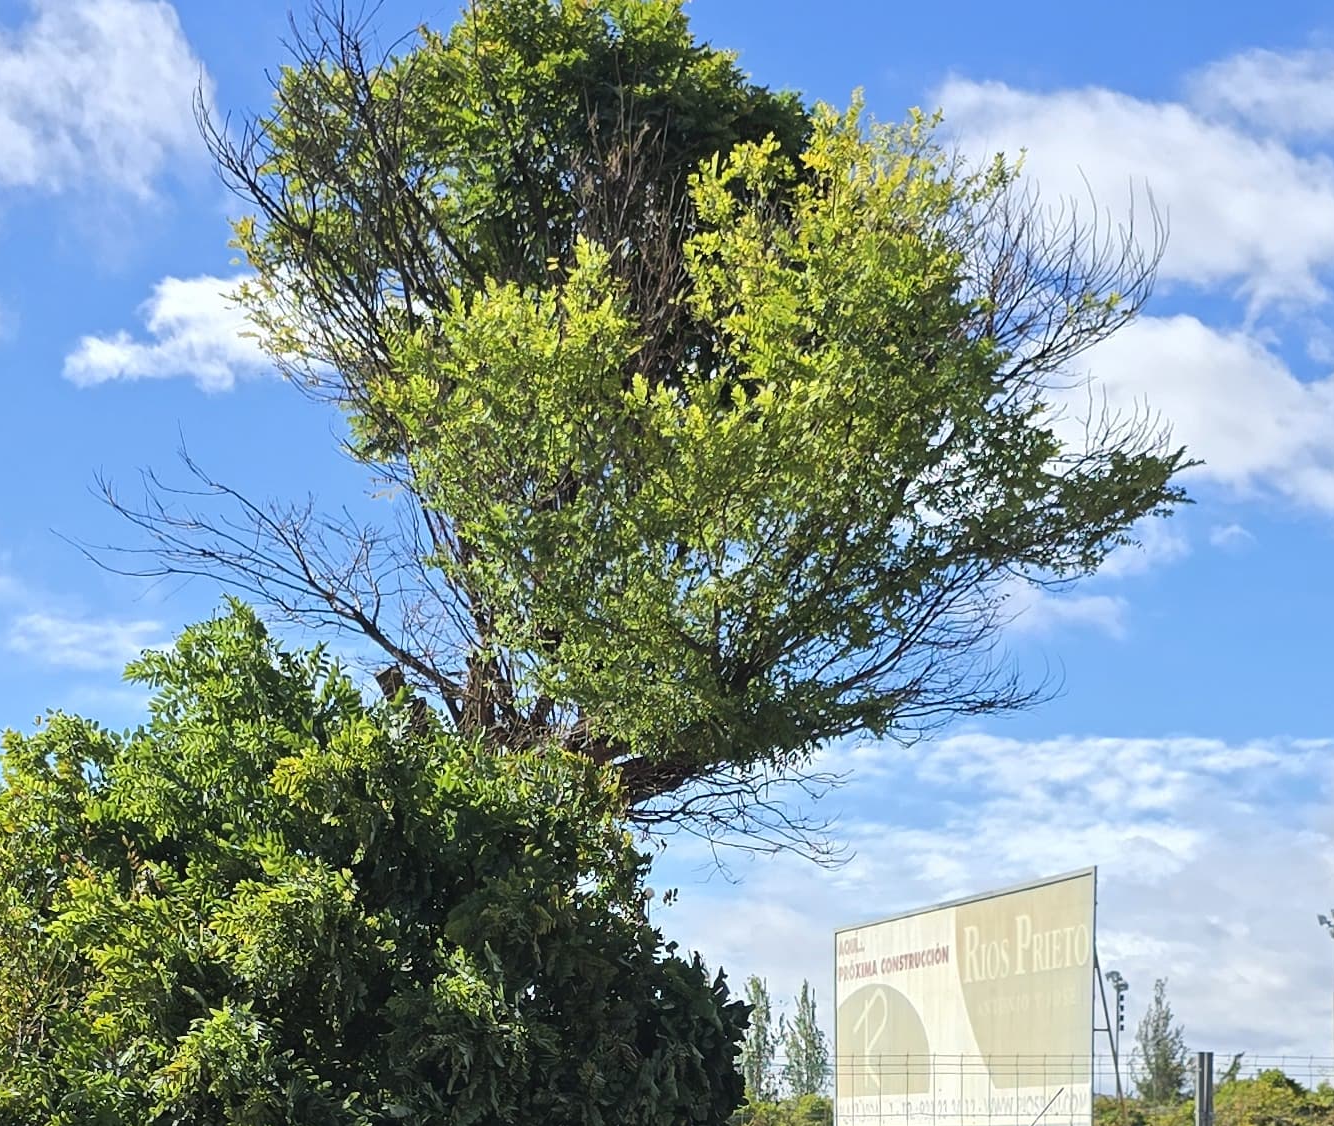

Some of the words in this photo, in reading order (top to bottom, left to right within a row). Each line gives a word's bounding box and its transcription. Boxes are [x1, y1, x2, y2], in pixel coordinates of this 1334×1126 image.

[838, 958, 878, 982] PRÓXIMA
[880, 942, 950, 975] CONSTRUCCIÓN
[963, 924, 1011, 985] RIOS
[1014, 913, 1090, 976] PRIETO
